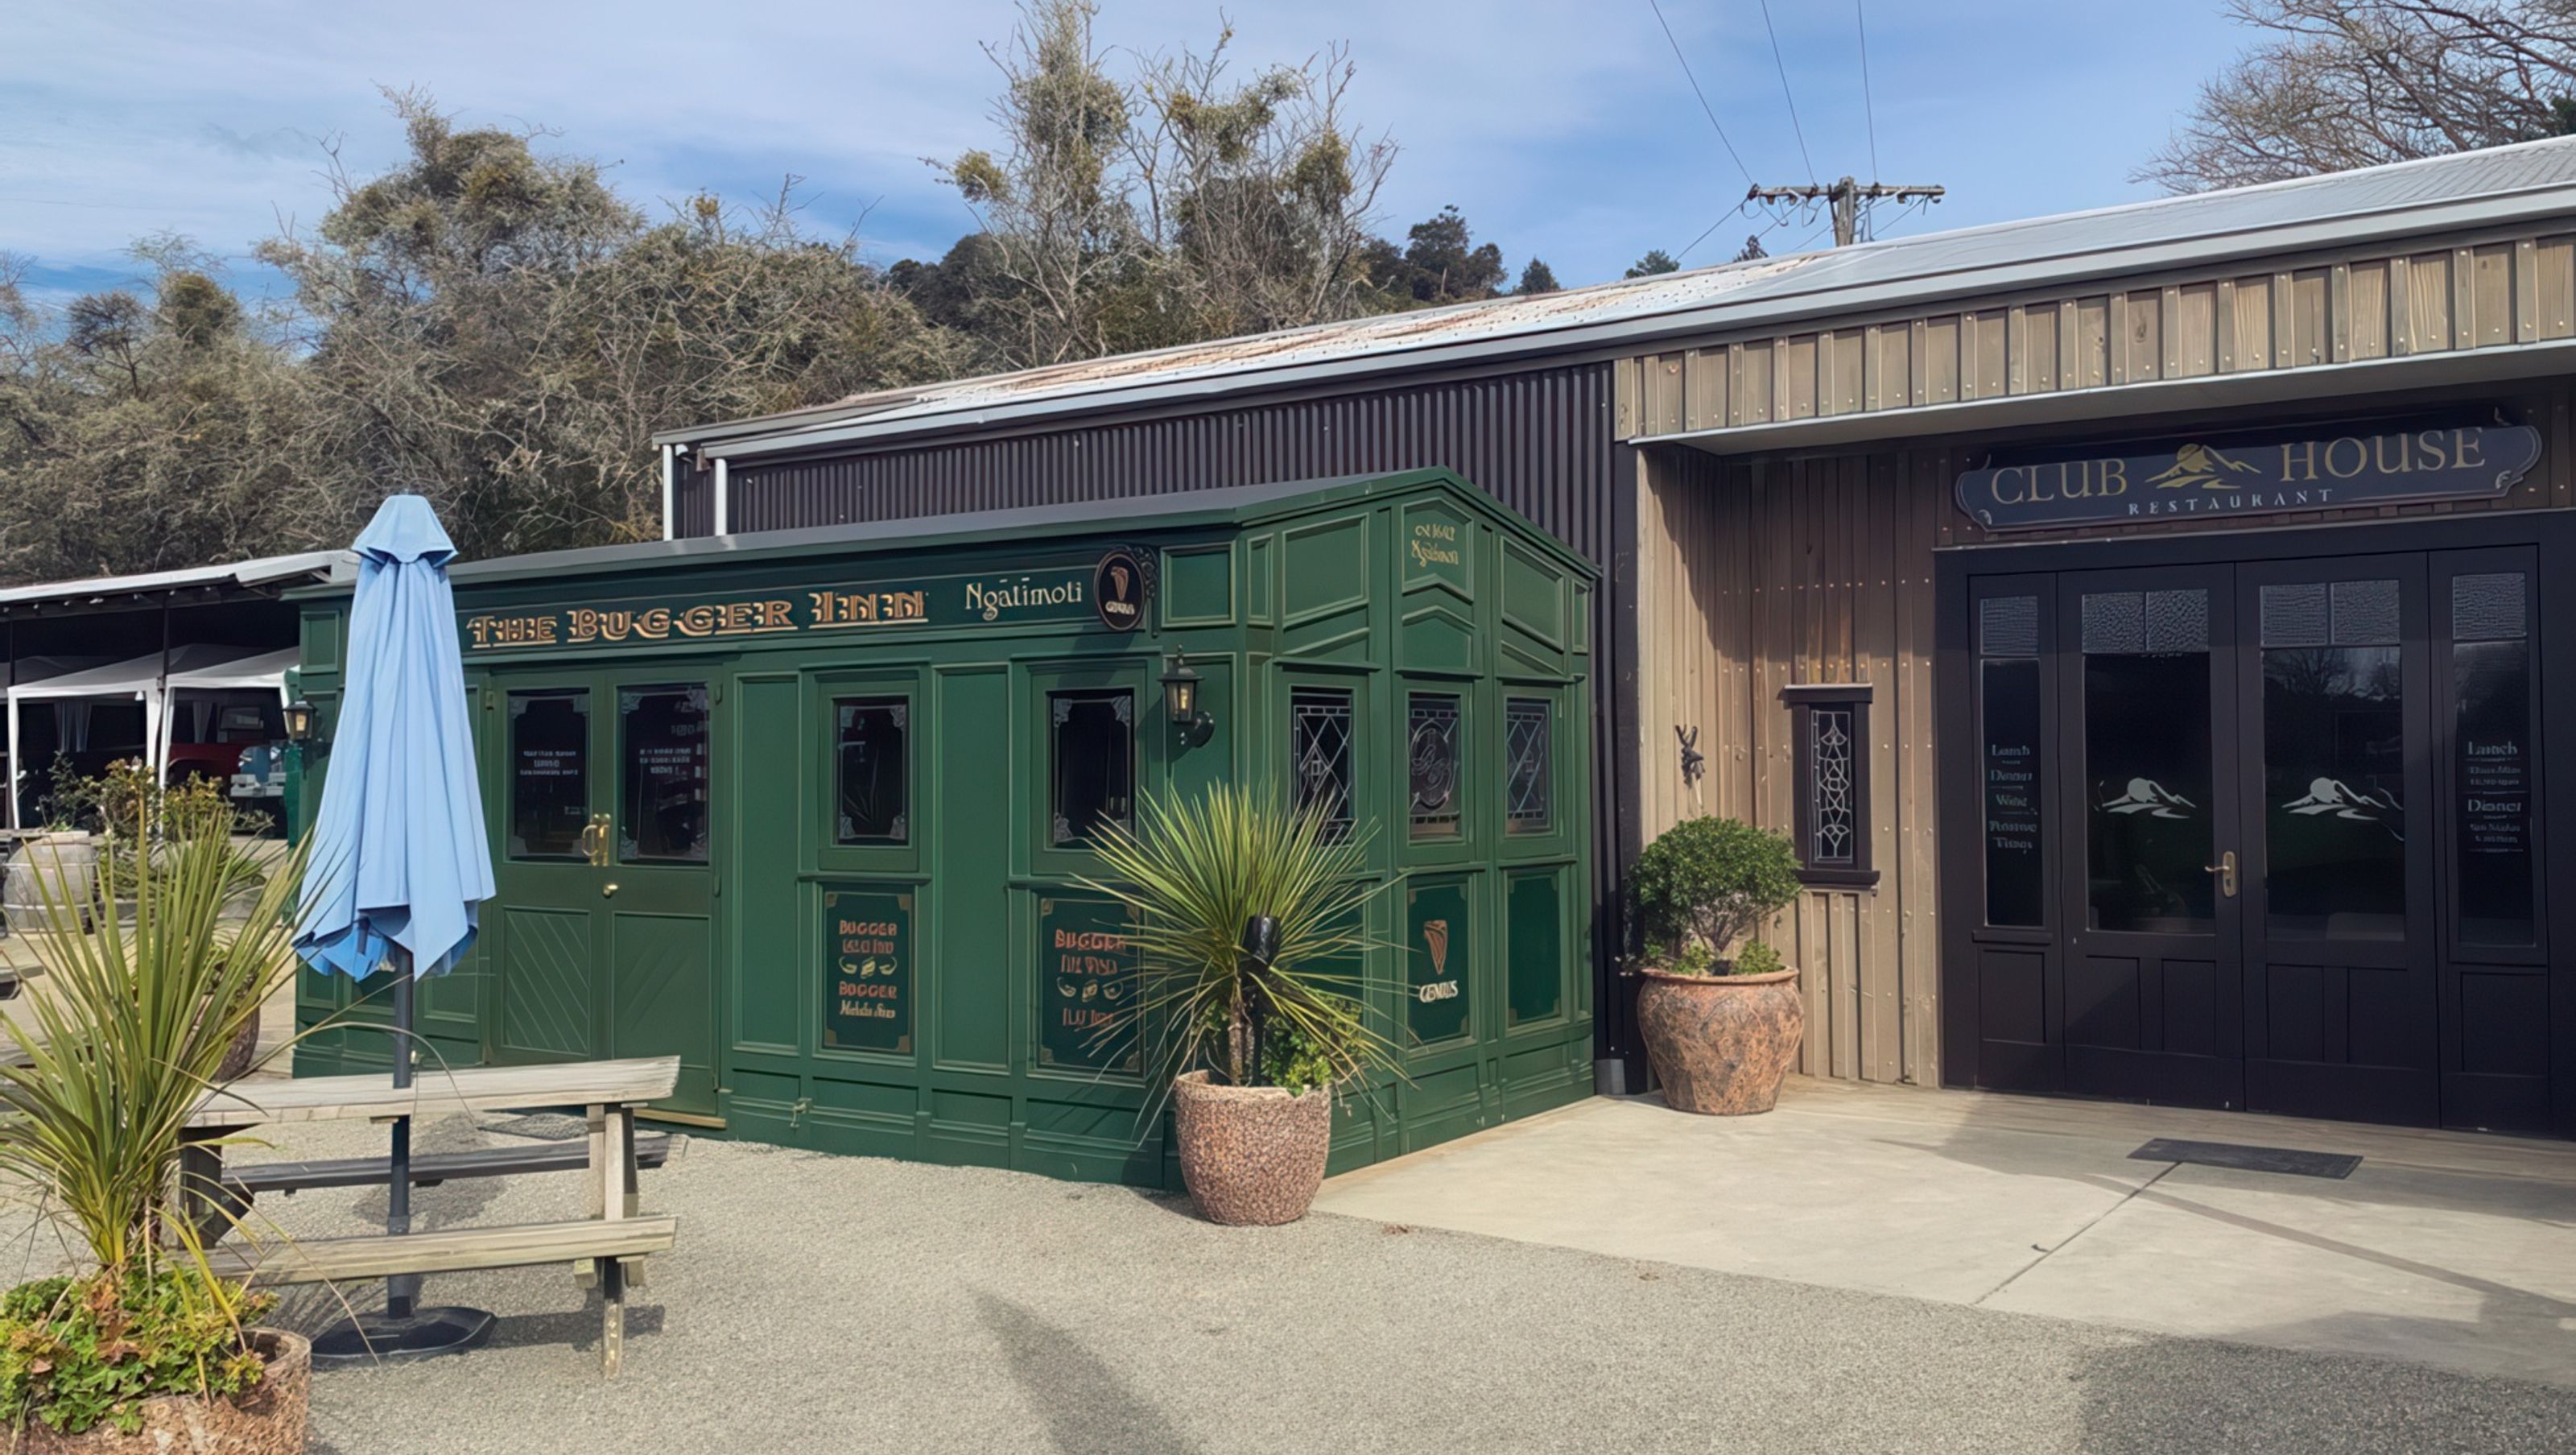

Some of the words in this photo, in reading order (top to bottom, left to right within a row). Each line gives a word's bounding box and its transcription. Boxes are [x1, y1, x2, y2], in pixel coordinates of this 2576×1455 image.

[1991, 457, 2128, 505] CLUB
[2279, 426, 2486, 482] HOUSE
[2128, 488, 2333, 516] RESTAURANT
[466, 614, 557, 649] THE
[567, 600, 799, 643] BUGGER
